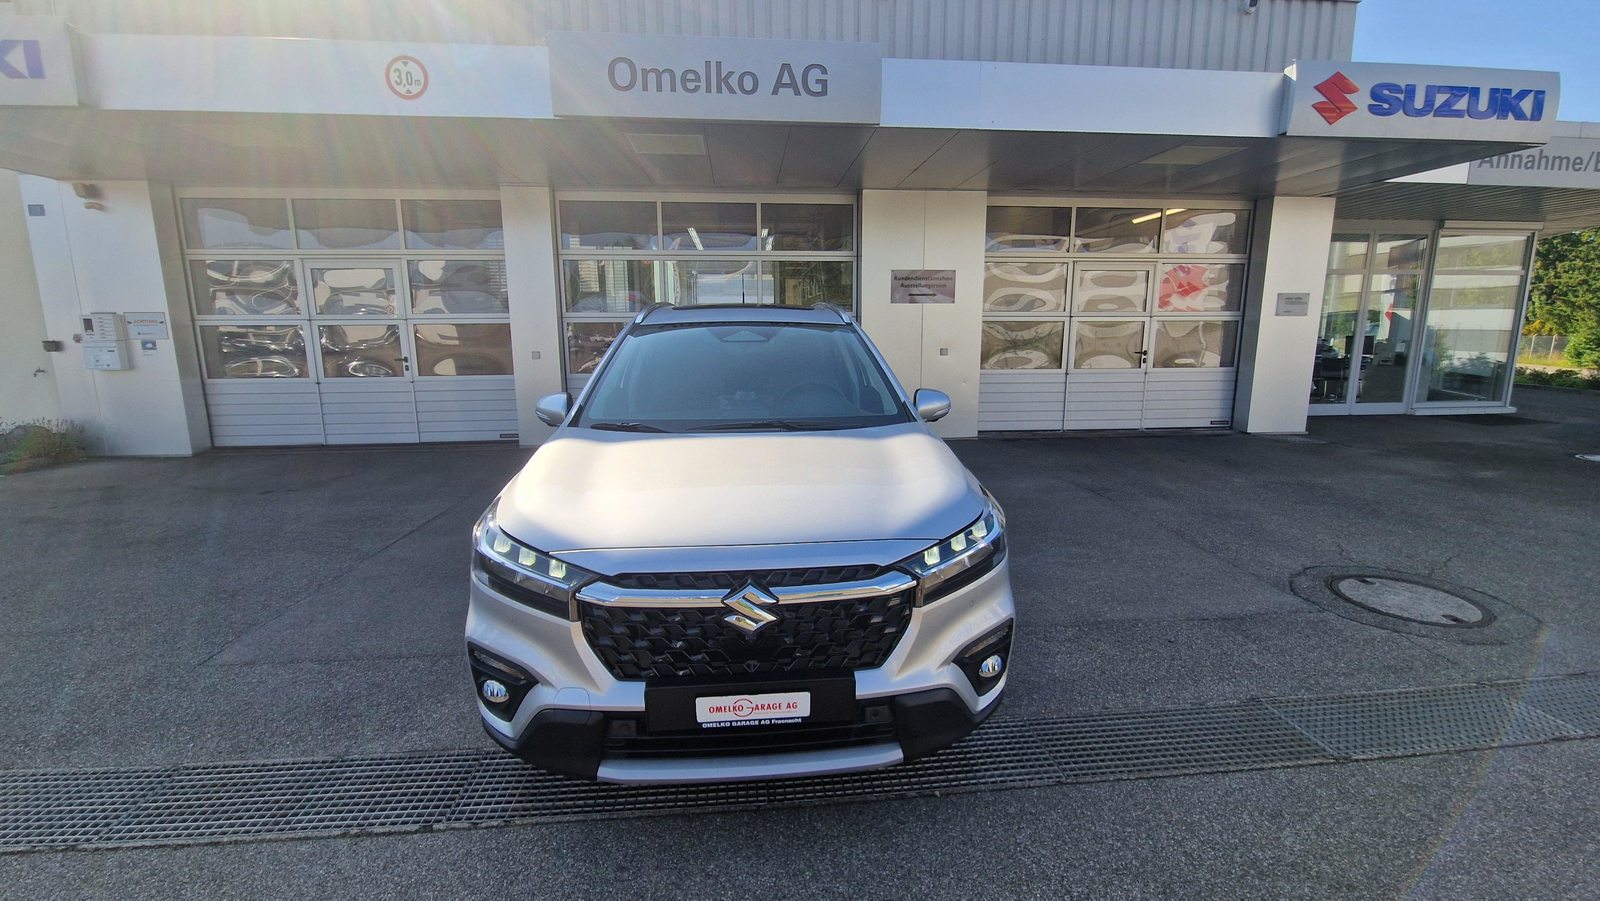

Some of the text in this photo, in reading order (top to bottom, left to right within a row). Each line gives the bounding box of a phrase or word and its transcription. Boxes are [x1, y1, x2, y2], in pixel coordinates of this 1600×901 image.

[607, 56, 829, 98] Omelko AG
[1367, 82, 1546, 122] SUZUKI
[708, 704, 744, 714] OMELKO
[786, 702, 798, 710] AG
